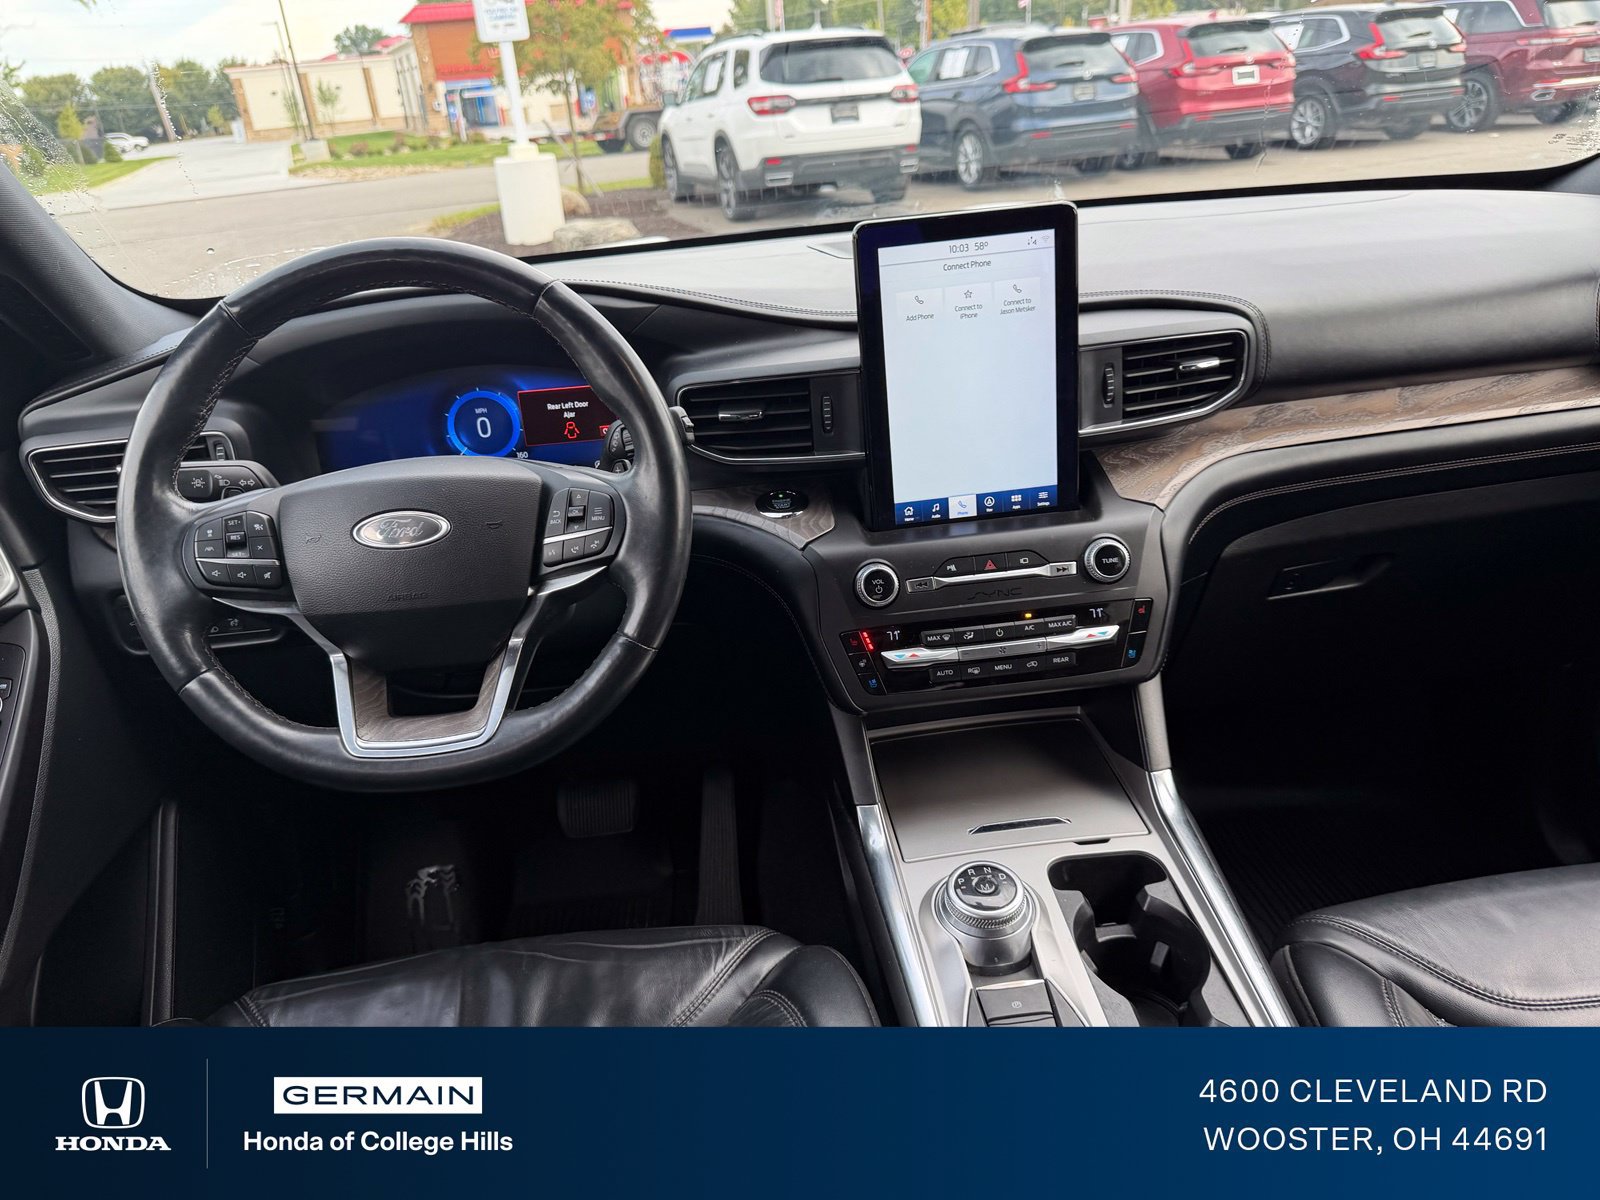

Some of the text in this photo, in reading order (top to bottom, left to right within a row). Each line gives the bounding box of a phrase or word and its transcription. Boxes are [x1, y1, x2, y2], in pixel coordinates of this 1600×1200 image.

[949, 243, 970, 254] 10:03
[943, 259, 992, 272] Connect Phone
[1003, 299, 1024, 307] Connect
[563, 411, 576, 419] Ajar
[476, 416, 492, 438] 0
[376, 517, 425, 539] Ford
[1101, 556, 1119, 564] TUNE
[936, 669, 954, 677] AUTO
[967, 868, 976, 876] R
